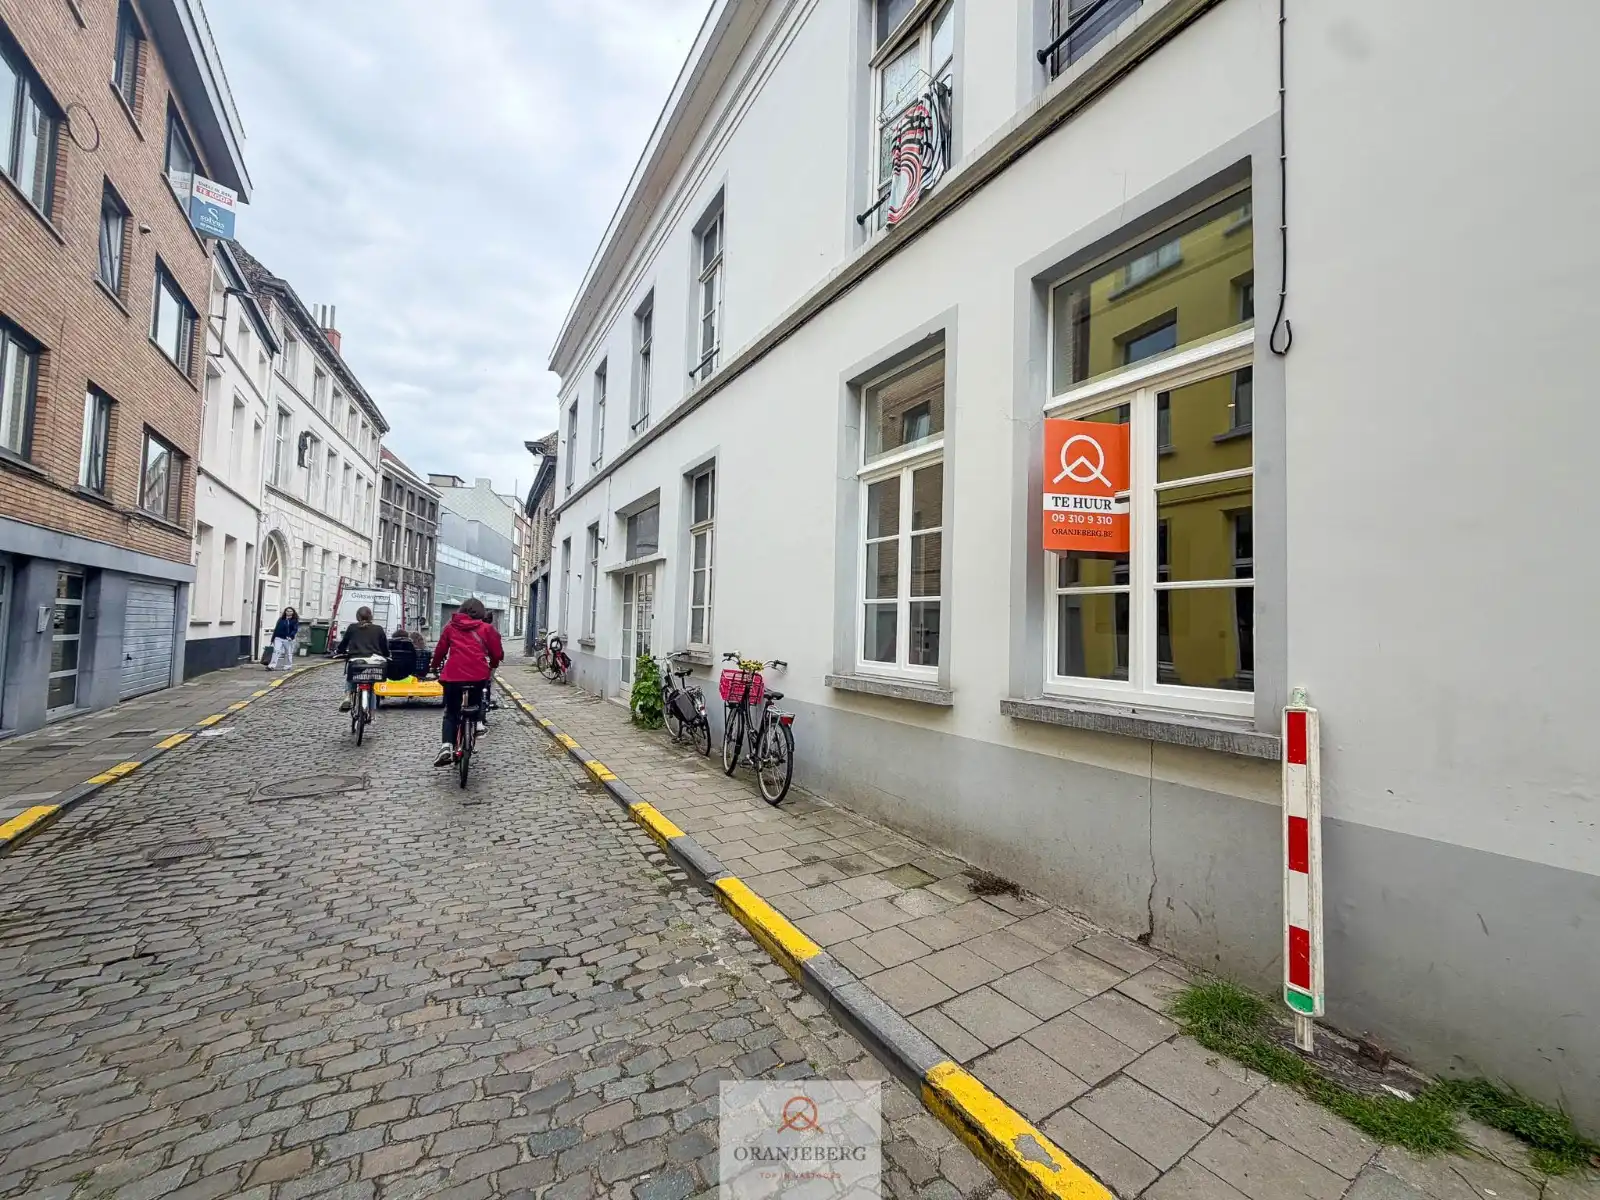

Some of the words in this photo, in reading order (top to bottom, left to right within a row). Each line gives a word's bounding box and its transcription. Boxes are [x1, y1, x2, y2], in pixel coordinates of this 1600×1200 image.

[198, 187, 209, 197] TE
[209, 191, 232, 205] KOOP
[1052, 496, 1070, 508] TE
[1073, 497, 1112, 510] HUUR
[1052, 513, 1065, 523] 09
[1067, 514, 1085, 524] 310
[1087, 515, 1094, 524] 9
[1096, 516, 1113, 525] 310
[1051, 528, 1113, 538] ORANJEBERG.BE
